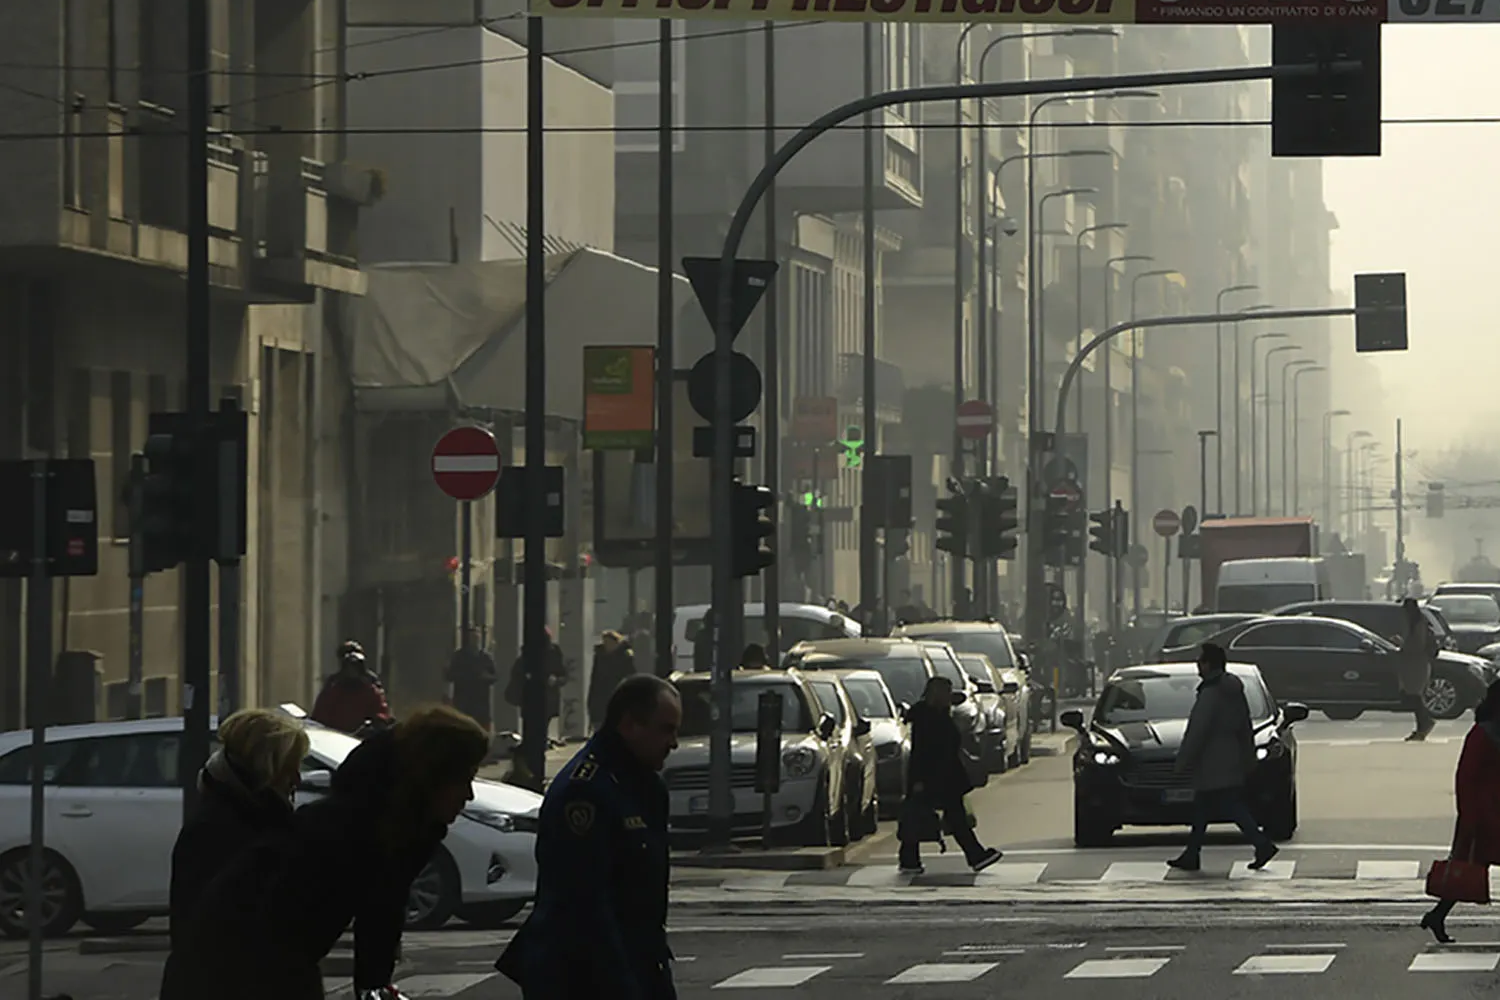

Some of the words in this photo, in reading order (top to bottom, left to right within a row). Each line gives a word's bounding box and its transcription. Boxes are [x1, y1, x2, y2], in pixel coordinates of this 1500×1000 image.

[1160, 6, 1224, 17] FIRMANDO
[1227, 6, 1246, 17] UN
[1247, 6, 1318, 17] CONTRATTO
